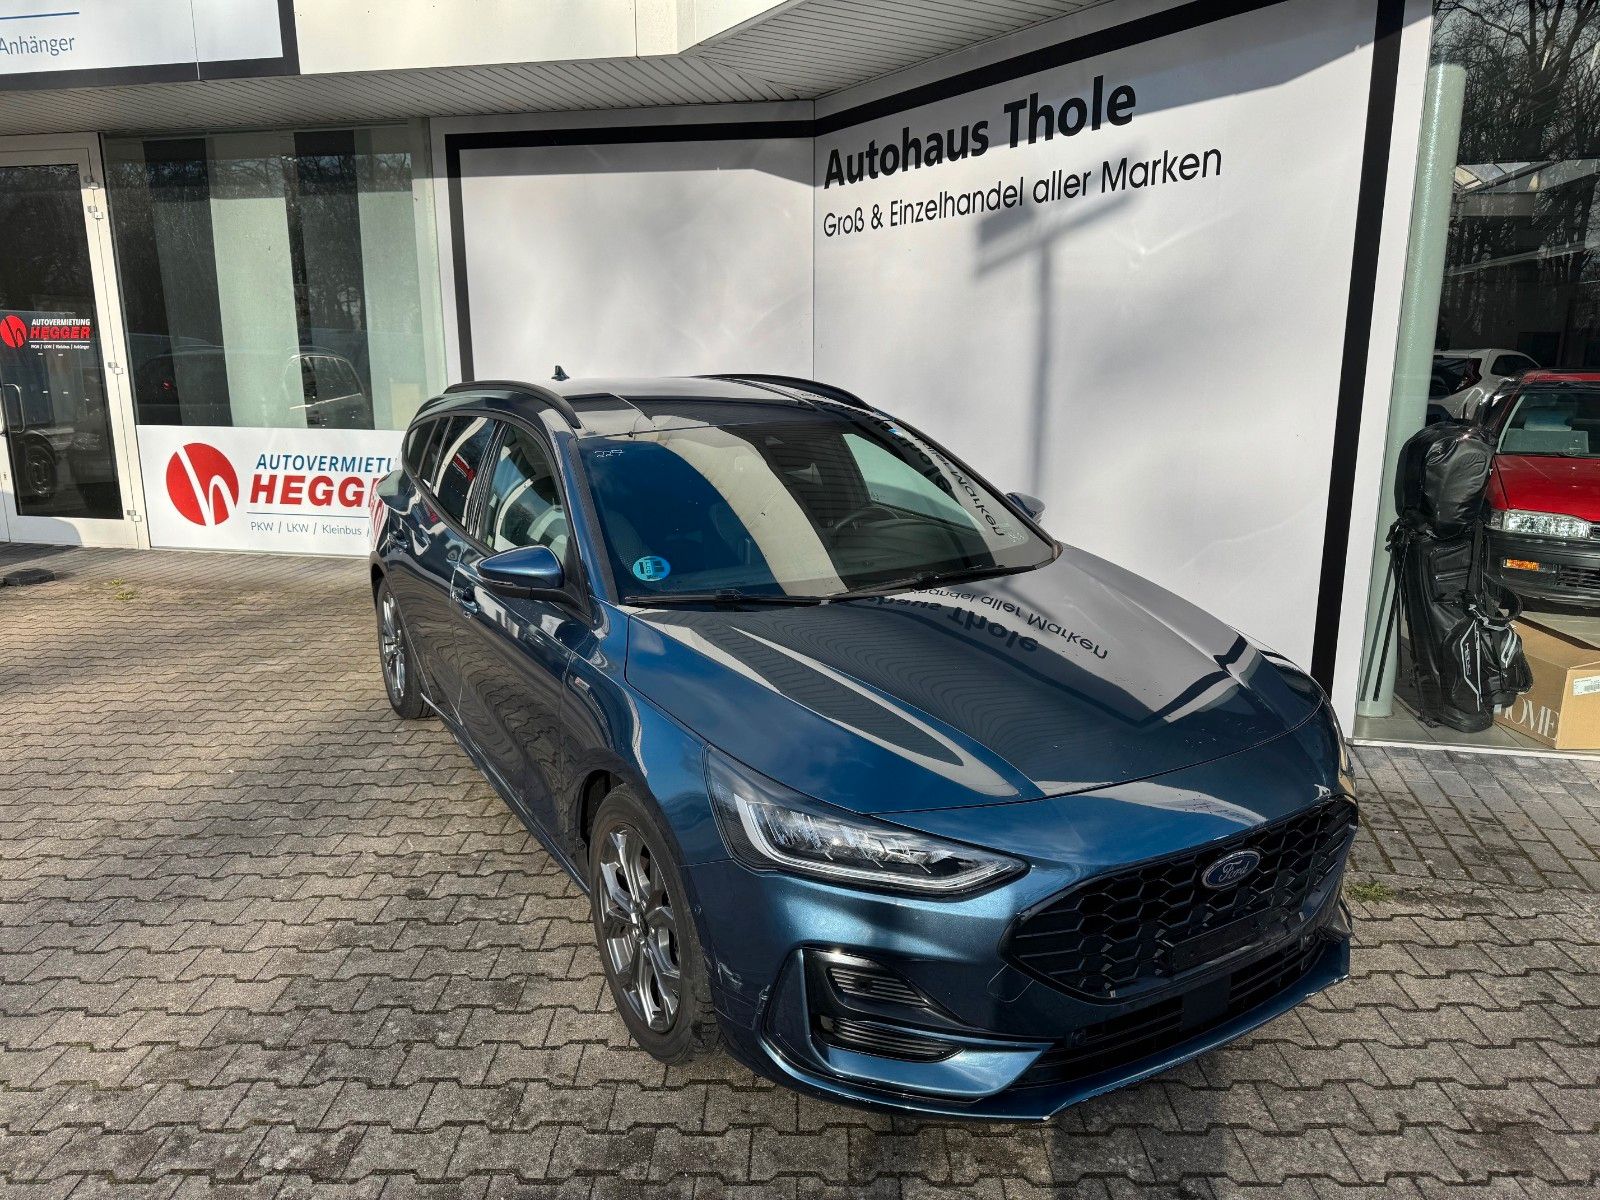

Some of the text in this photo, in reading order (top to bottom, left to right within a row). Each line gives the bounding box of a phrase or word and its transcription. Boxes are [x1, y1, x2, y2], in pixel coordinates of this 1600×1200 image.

[0, 36, 75, 56] Anhänger
[824, 75, 1137, 190] Autohaus Thole
[824, 148, 1222, 238] Groß & Einzelhandel aller Marken
[30, 326, 91, 339] HEGGER
[31, 318, 91, 326] AUTOVERMIETUNG
[250, 522, 274, 532] PKW
[286, 522, 309, 533] LKW
[322, 524, 362, 535] Kleinbus
[1504, 695, 1560, 742] OME
[1218, 859, 1250, 883] Ford
